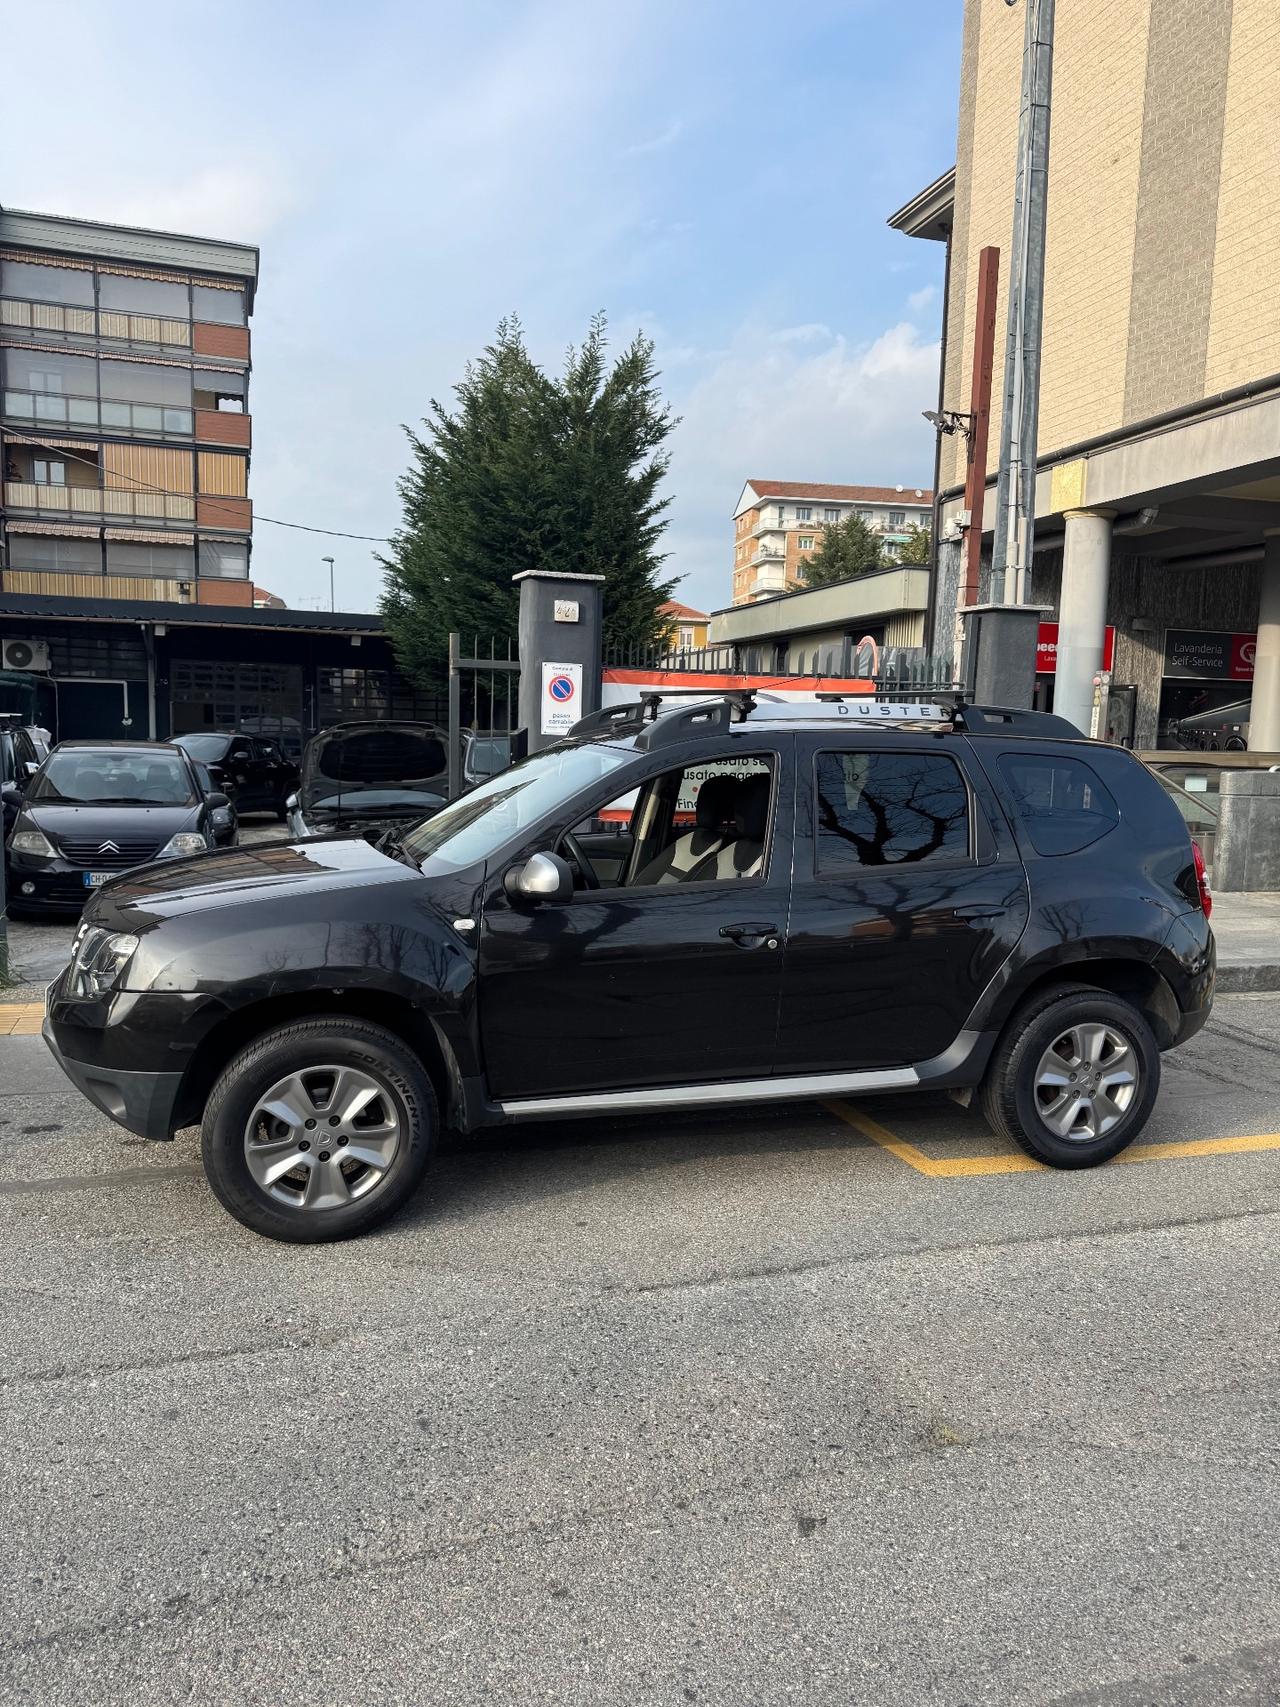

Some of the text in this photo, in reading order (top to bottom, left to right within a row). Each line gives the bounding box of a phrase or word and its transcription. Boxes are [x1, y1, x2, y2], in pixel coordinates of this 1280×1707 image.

[1174, 642, 1223, 654] Lavanderia
[1171, 655, 1223, 667] Self-Service
[683, 769, 716, 781] usato
